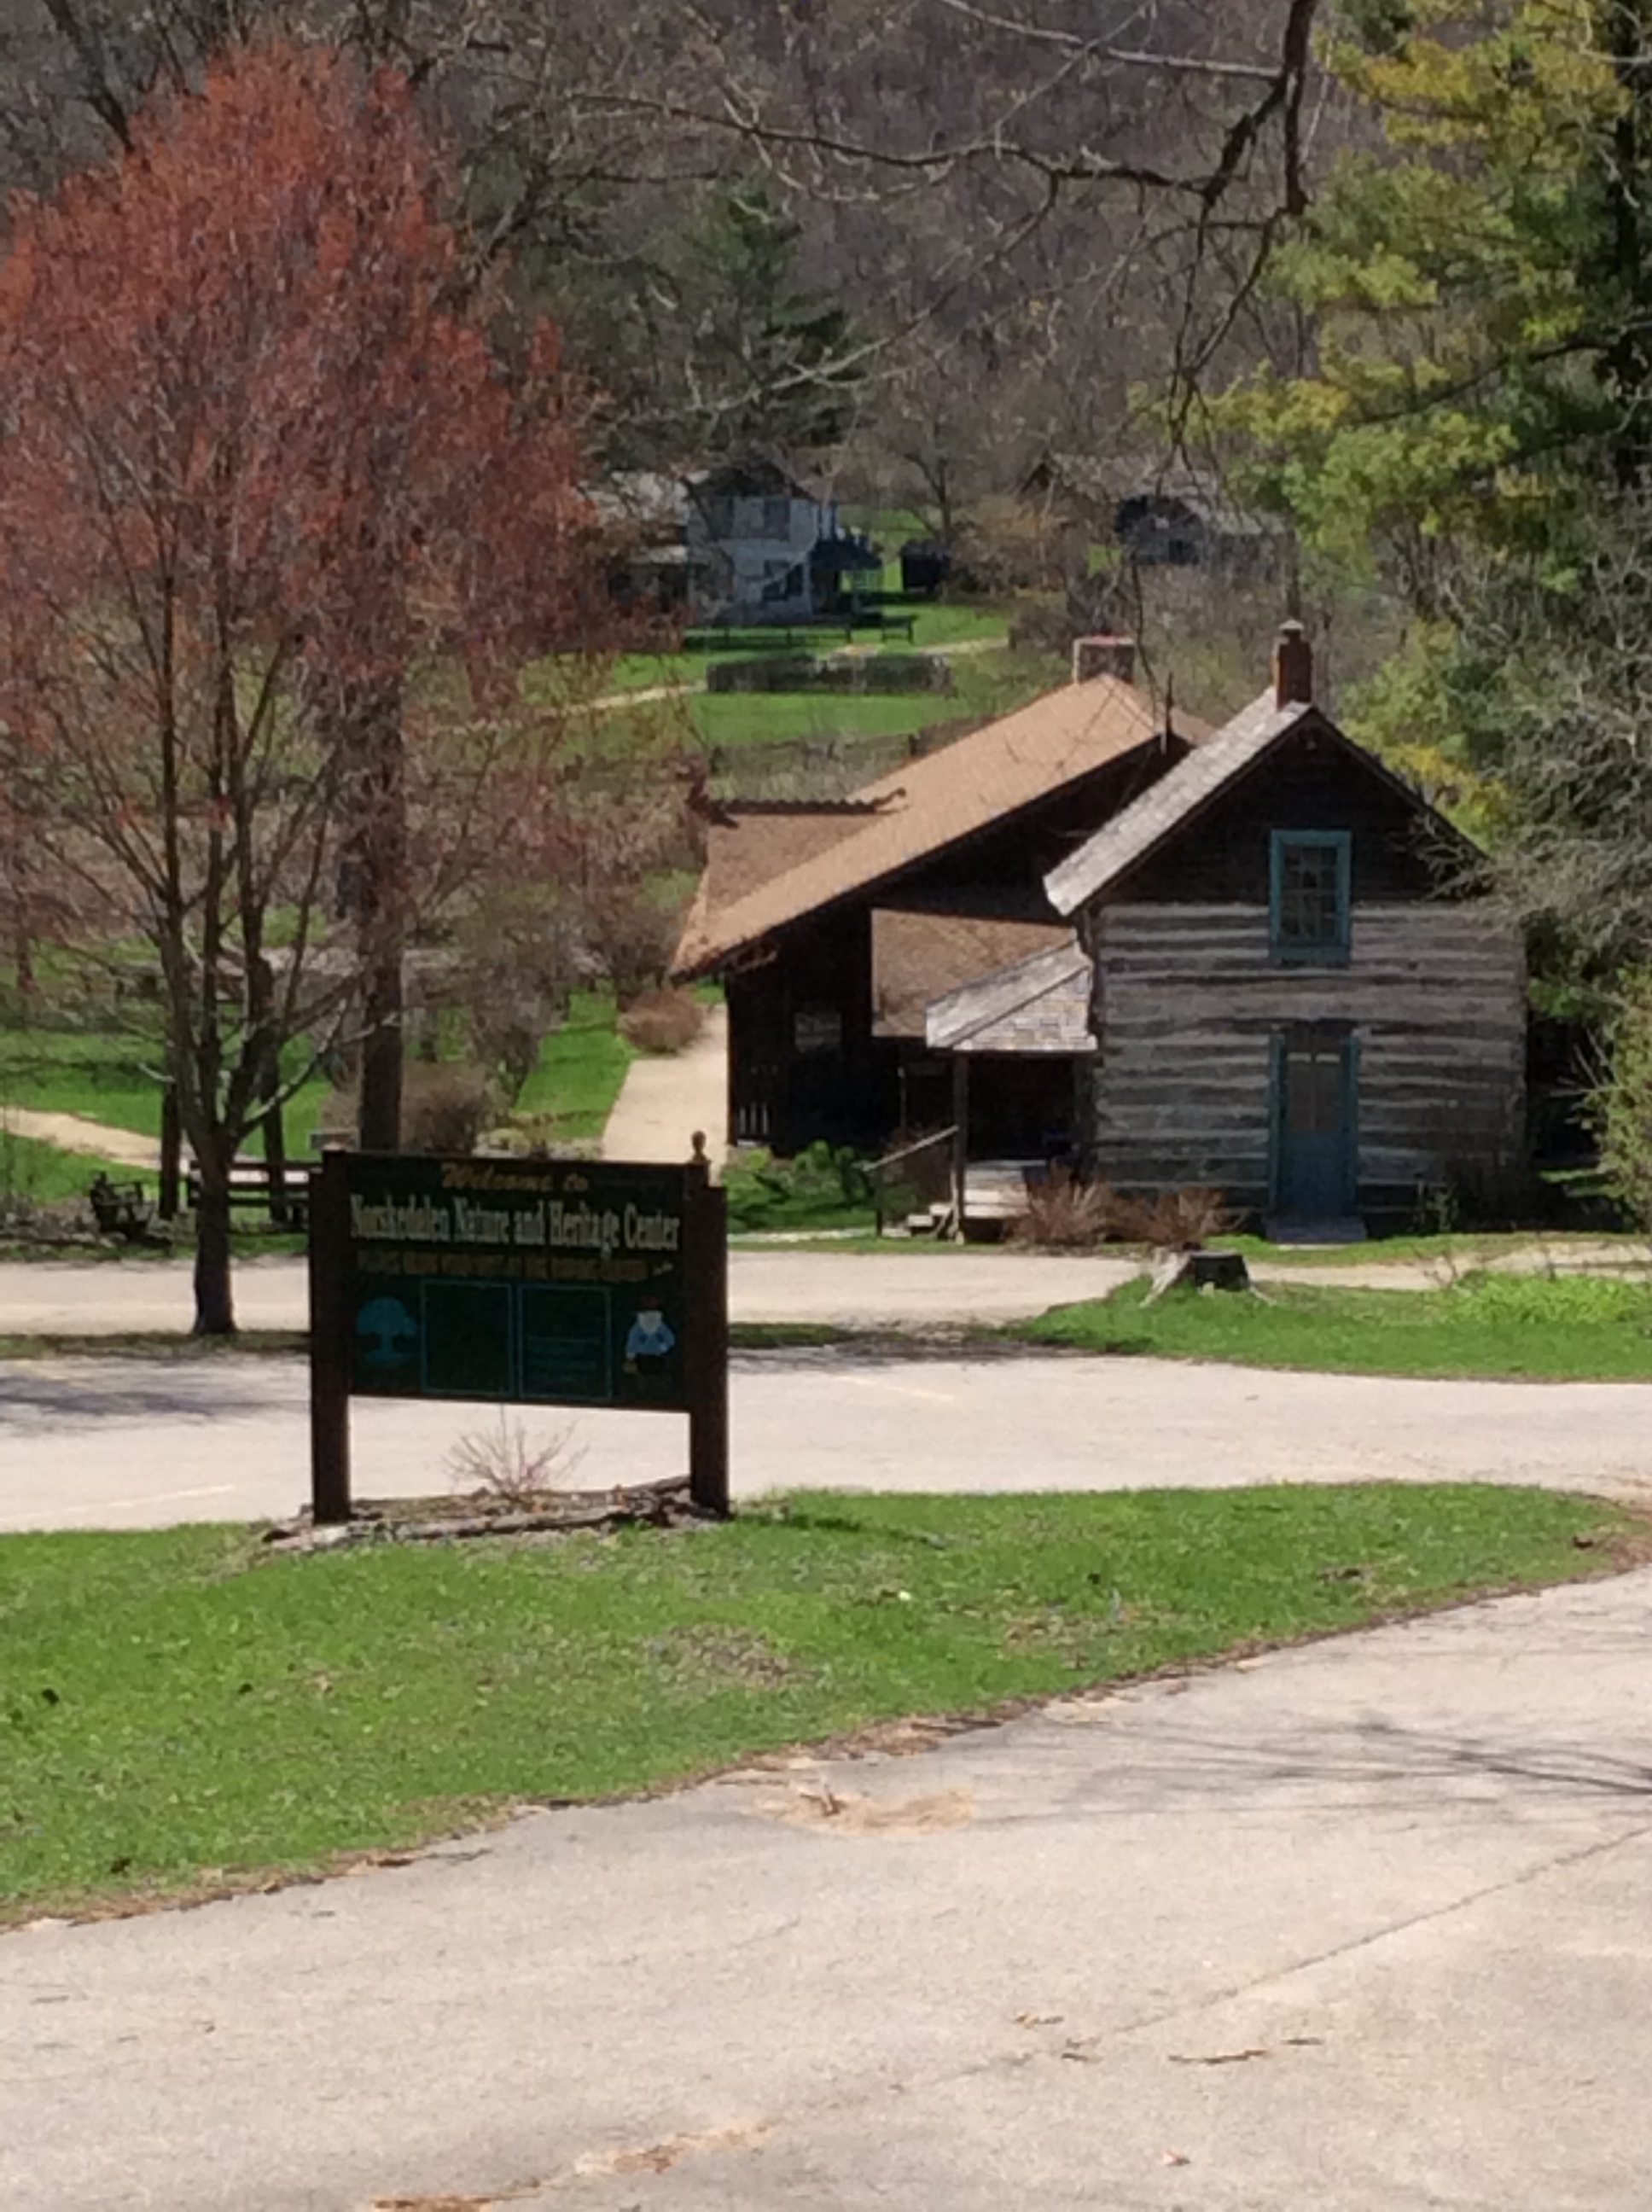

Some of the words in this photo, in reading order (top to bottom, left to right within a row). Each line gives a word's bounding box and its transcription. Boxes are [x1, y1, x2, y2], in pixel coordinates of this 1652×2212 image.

[441, 1162, 554, 1190] Welcome
[563, 1171, 590, 1192] to
[452, 1196, 510, 1244] Nature
[514, 1198, 546, 1246] and
[549, 1199, 620, 1261] Heritage
[624, 1202, 680, 1251] Center
